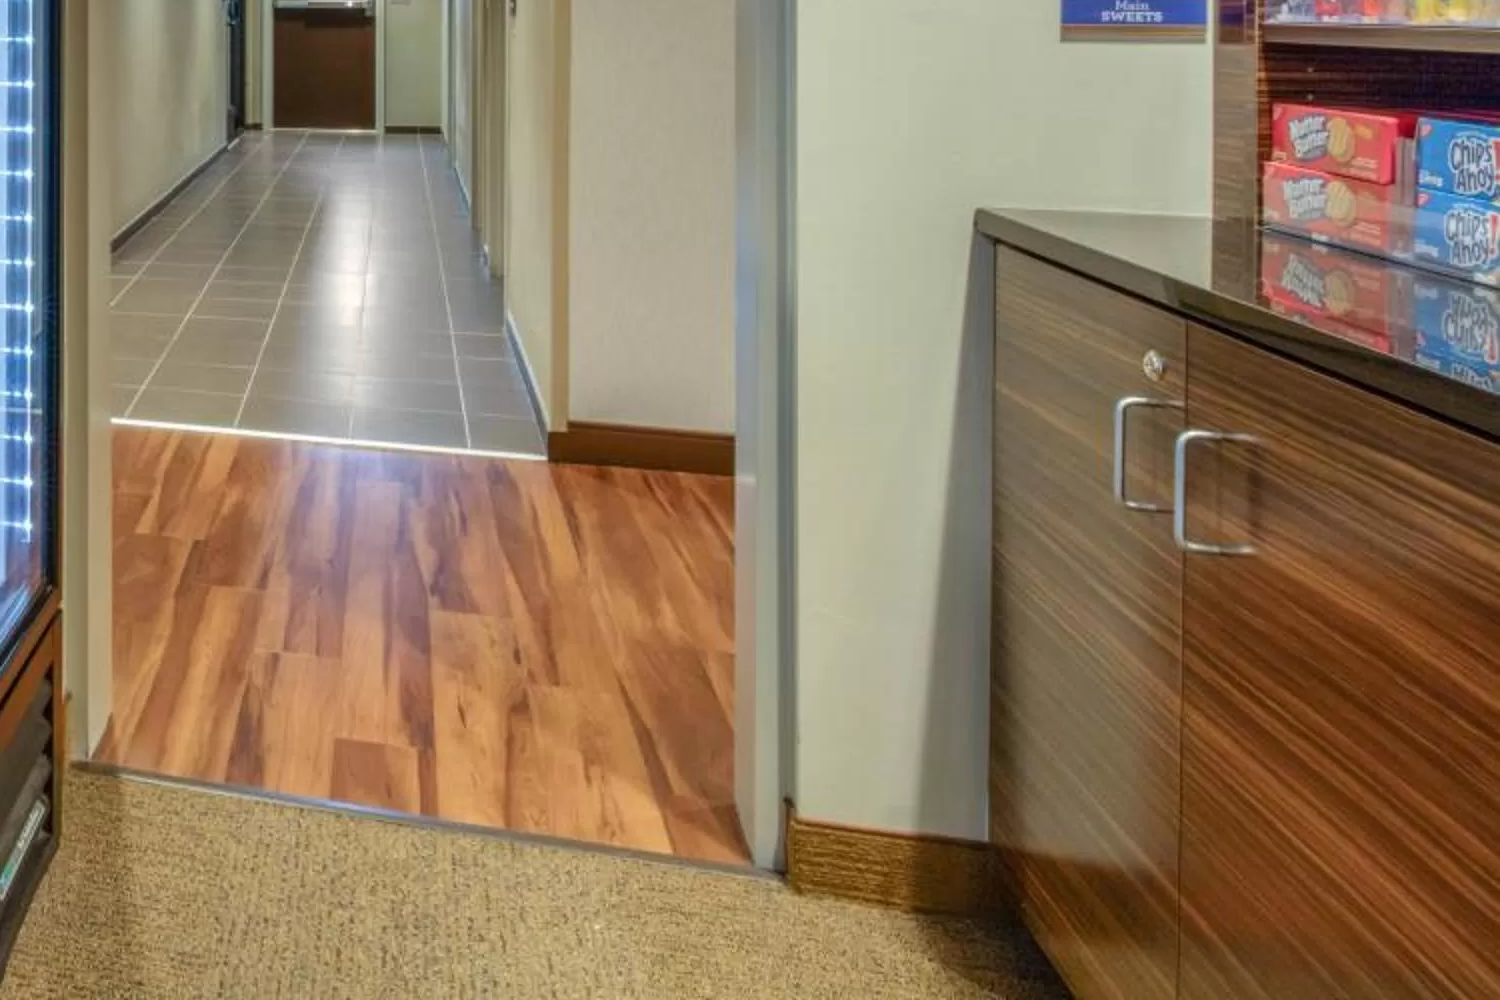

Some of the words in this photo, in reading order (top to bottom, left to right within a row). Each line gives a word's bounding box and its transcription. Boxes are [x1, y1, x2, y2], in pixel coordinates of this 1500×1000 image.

[1115, 0, 1149, 11] Main
[1101, 11, 1163, 23] SWEETS
[1450, 139, 1493, 171] Chips
